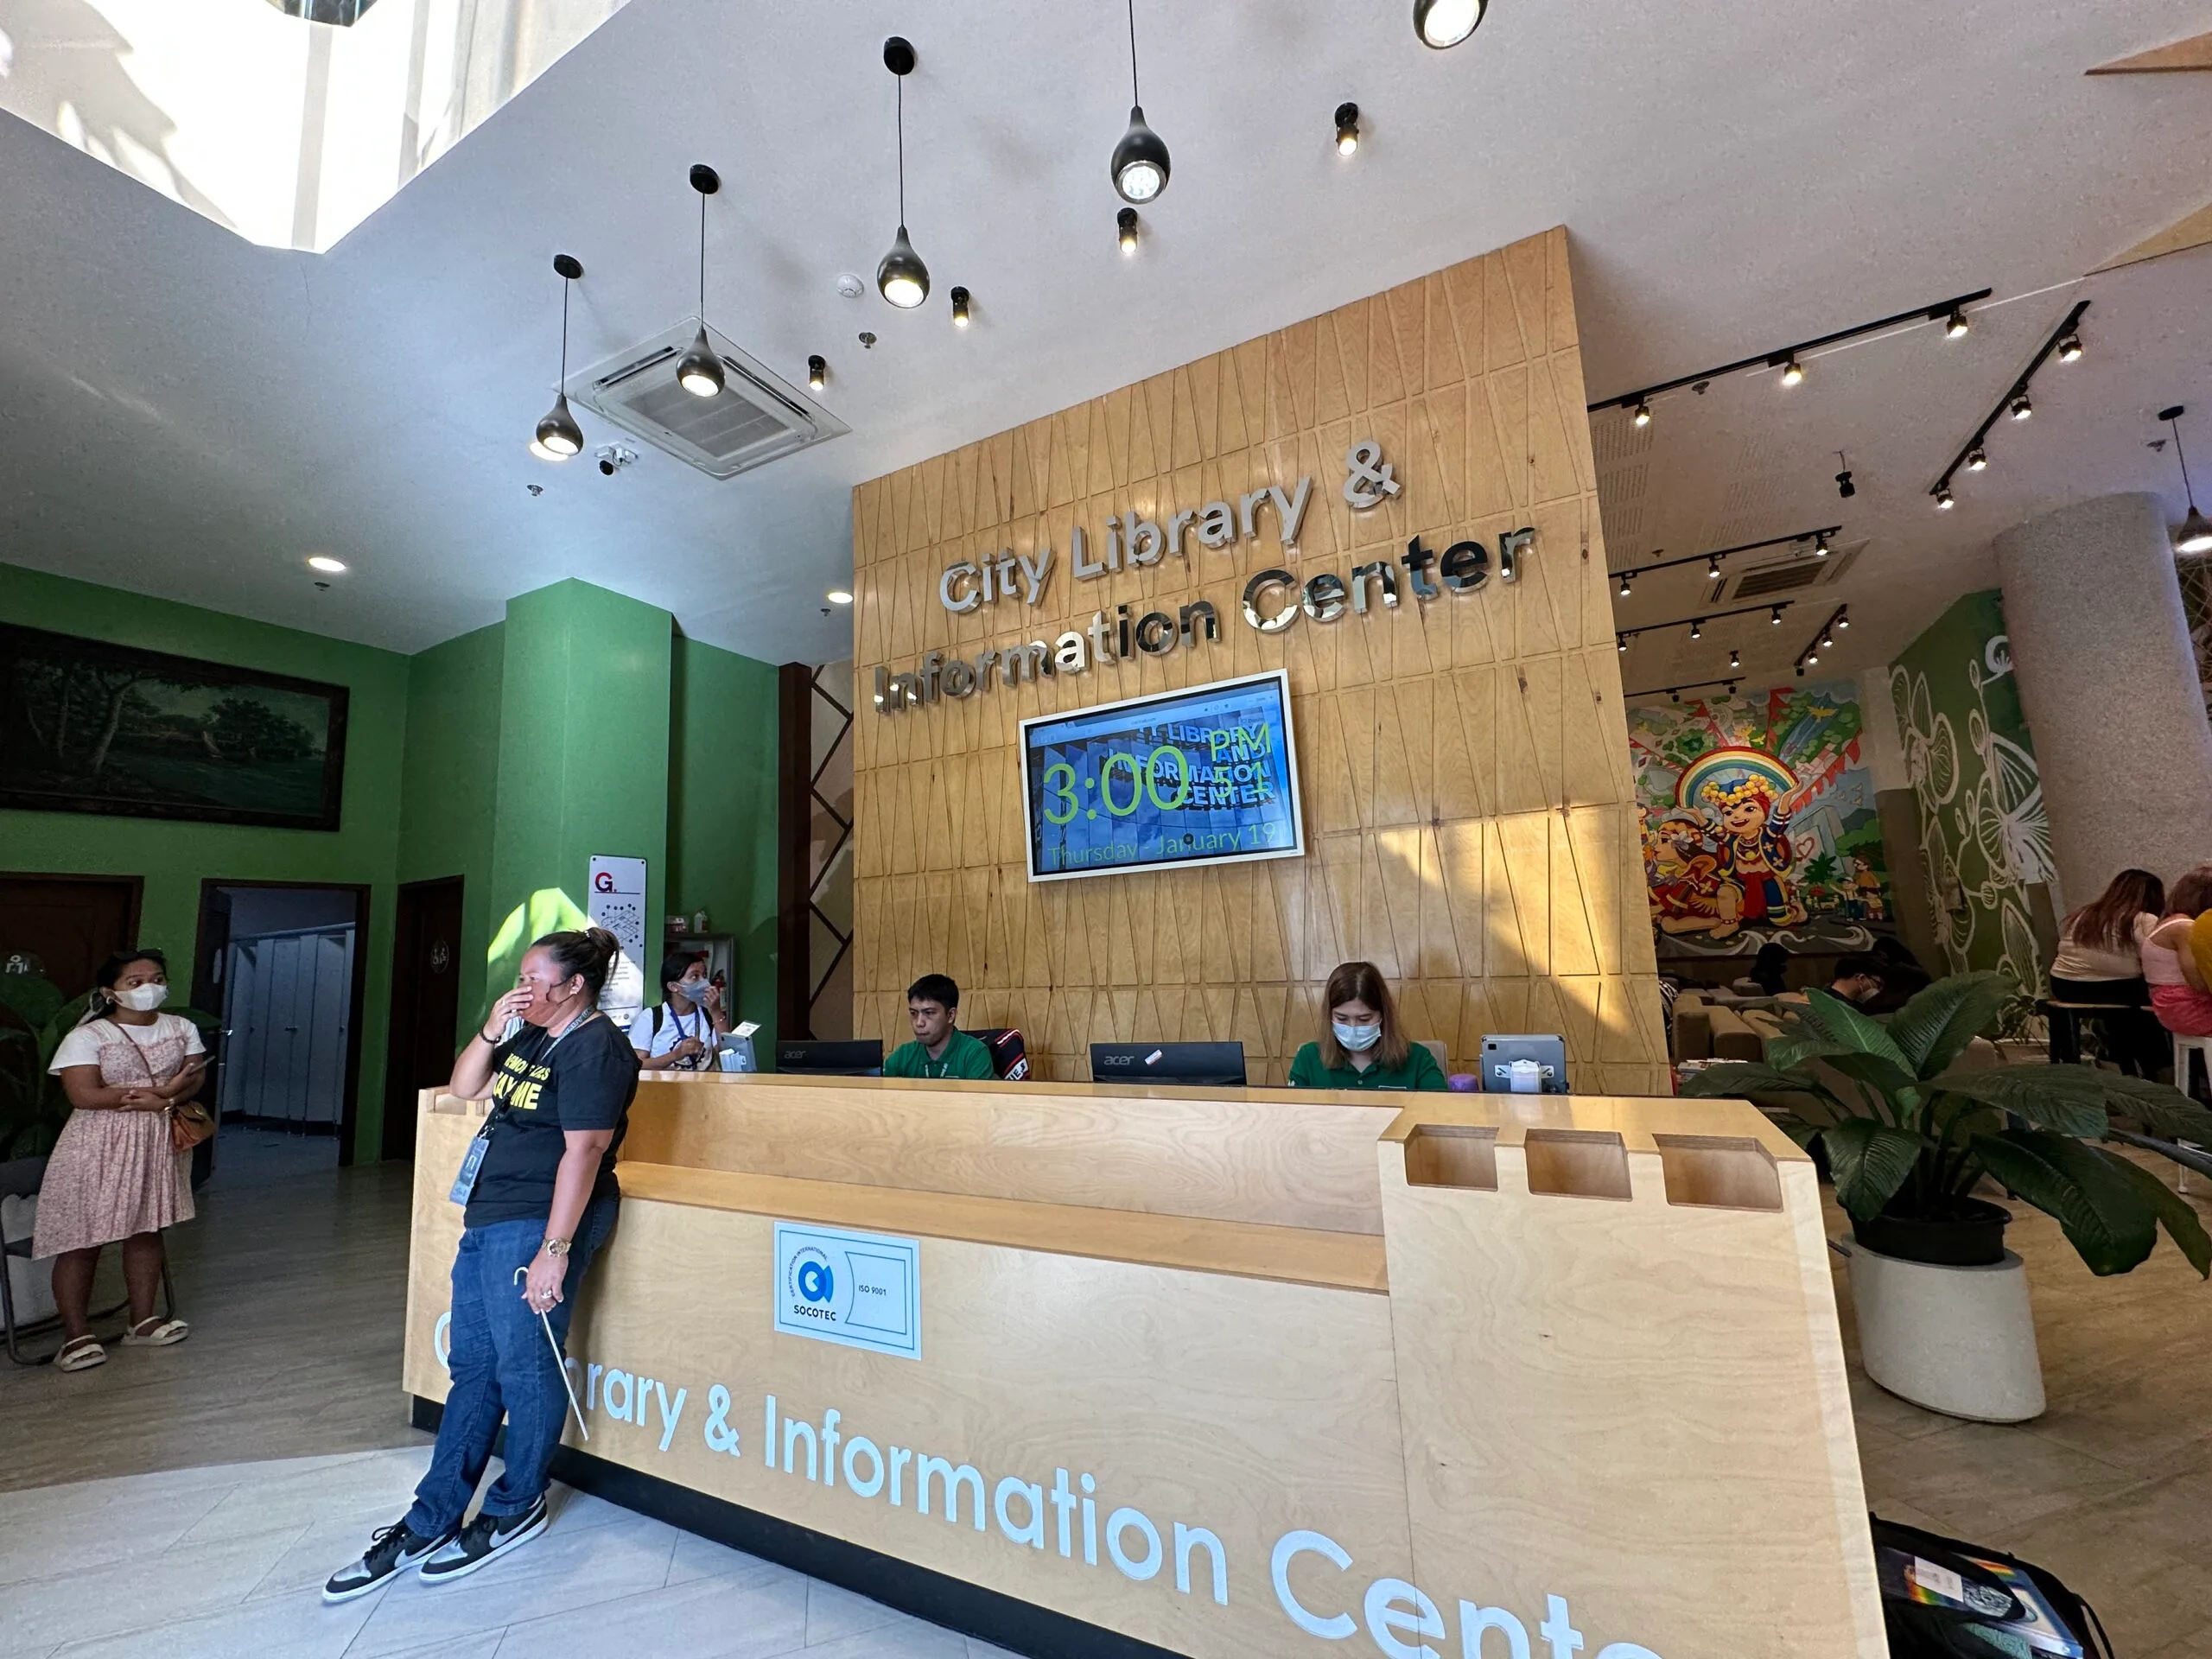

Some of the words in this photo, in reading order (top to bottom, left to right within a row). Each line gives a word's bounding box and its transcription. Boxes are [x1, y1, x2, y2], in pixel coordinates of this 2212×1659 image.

[939, 547, 1057, 613] City
[1071, 476, 1313, 581] Library
[1344, 441, 1401, 508] &
[874, 600, 1221, 714] Information
[1243, 527, 1535, 633] Center
[1211, 721, 1272, 762] PM
[1043, 745, 1190, 824] 3:00
[1177, 781, 1276, 805] CENTER
[1214, 761, 1269, 798] 51
[1048, 839, 1139, 866] Thursday
[1155, 829, 1241, 855] January
[1249, 822, 1276, 845] 19
[784, 1050, 806, 1059] acer
[1103, 1056, 1135, 1065] acer
[510, 1080, 543, 1110] ME
[858, 1285, 870, 1294] ISO
[871, 1286, 887, 1296] 9001
[793, 1305, 837, 1321] SOCOTEC
[704, 1383, 741, 1458] &
[764, 1395, 1229, 1606] Information
[1271, 1529, 1669, 1659] Cent
